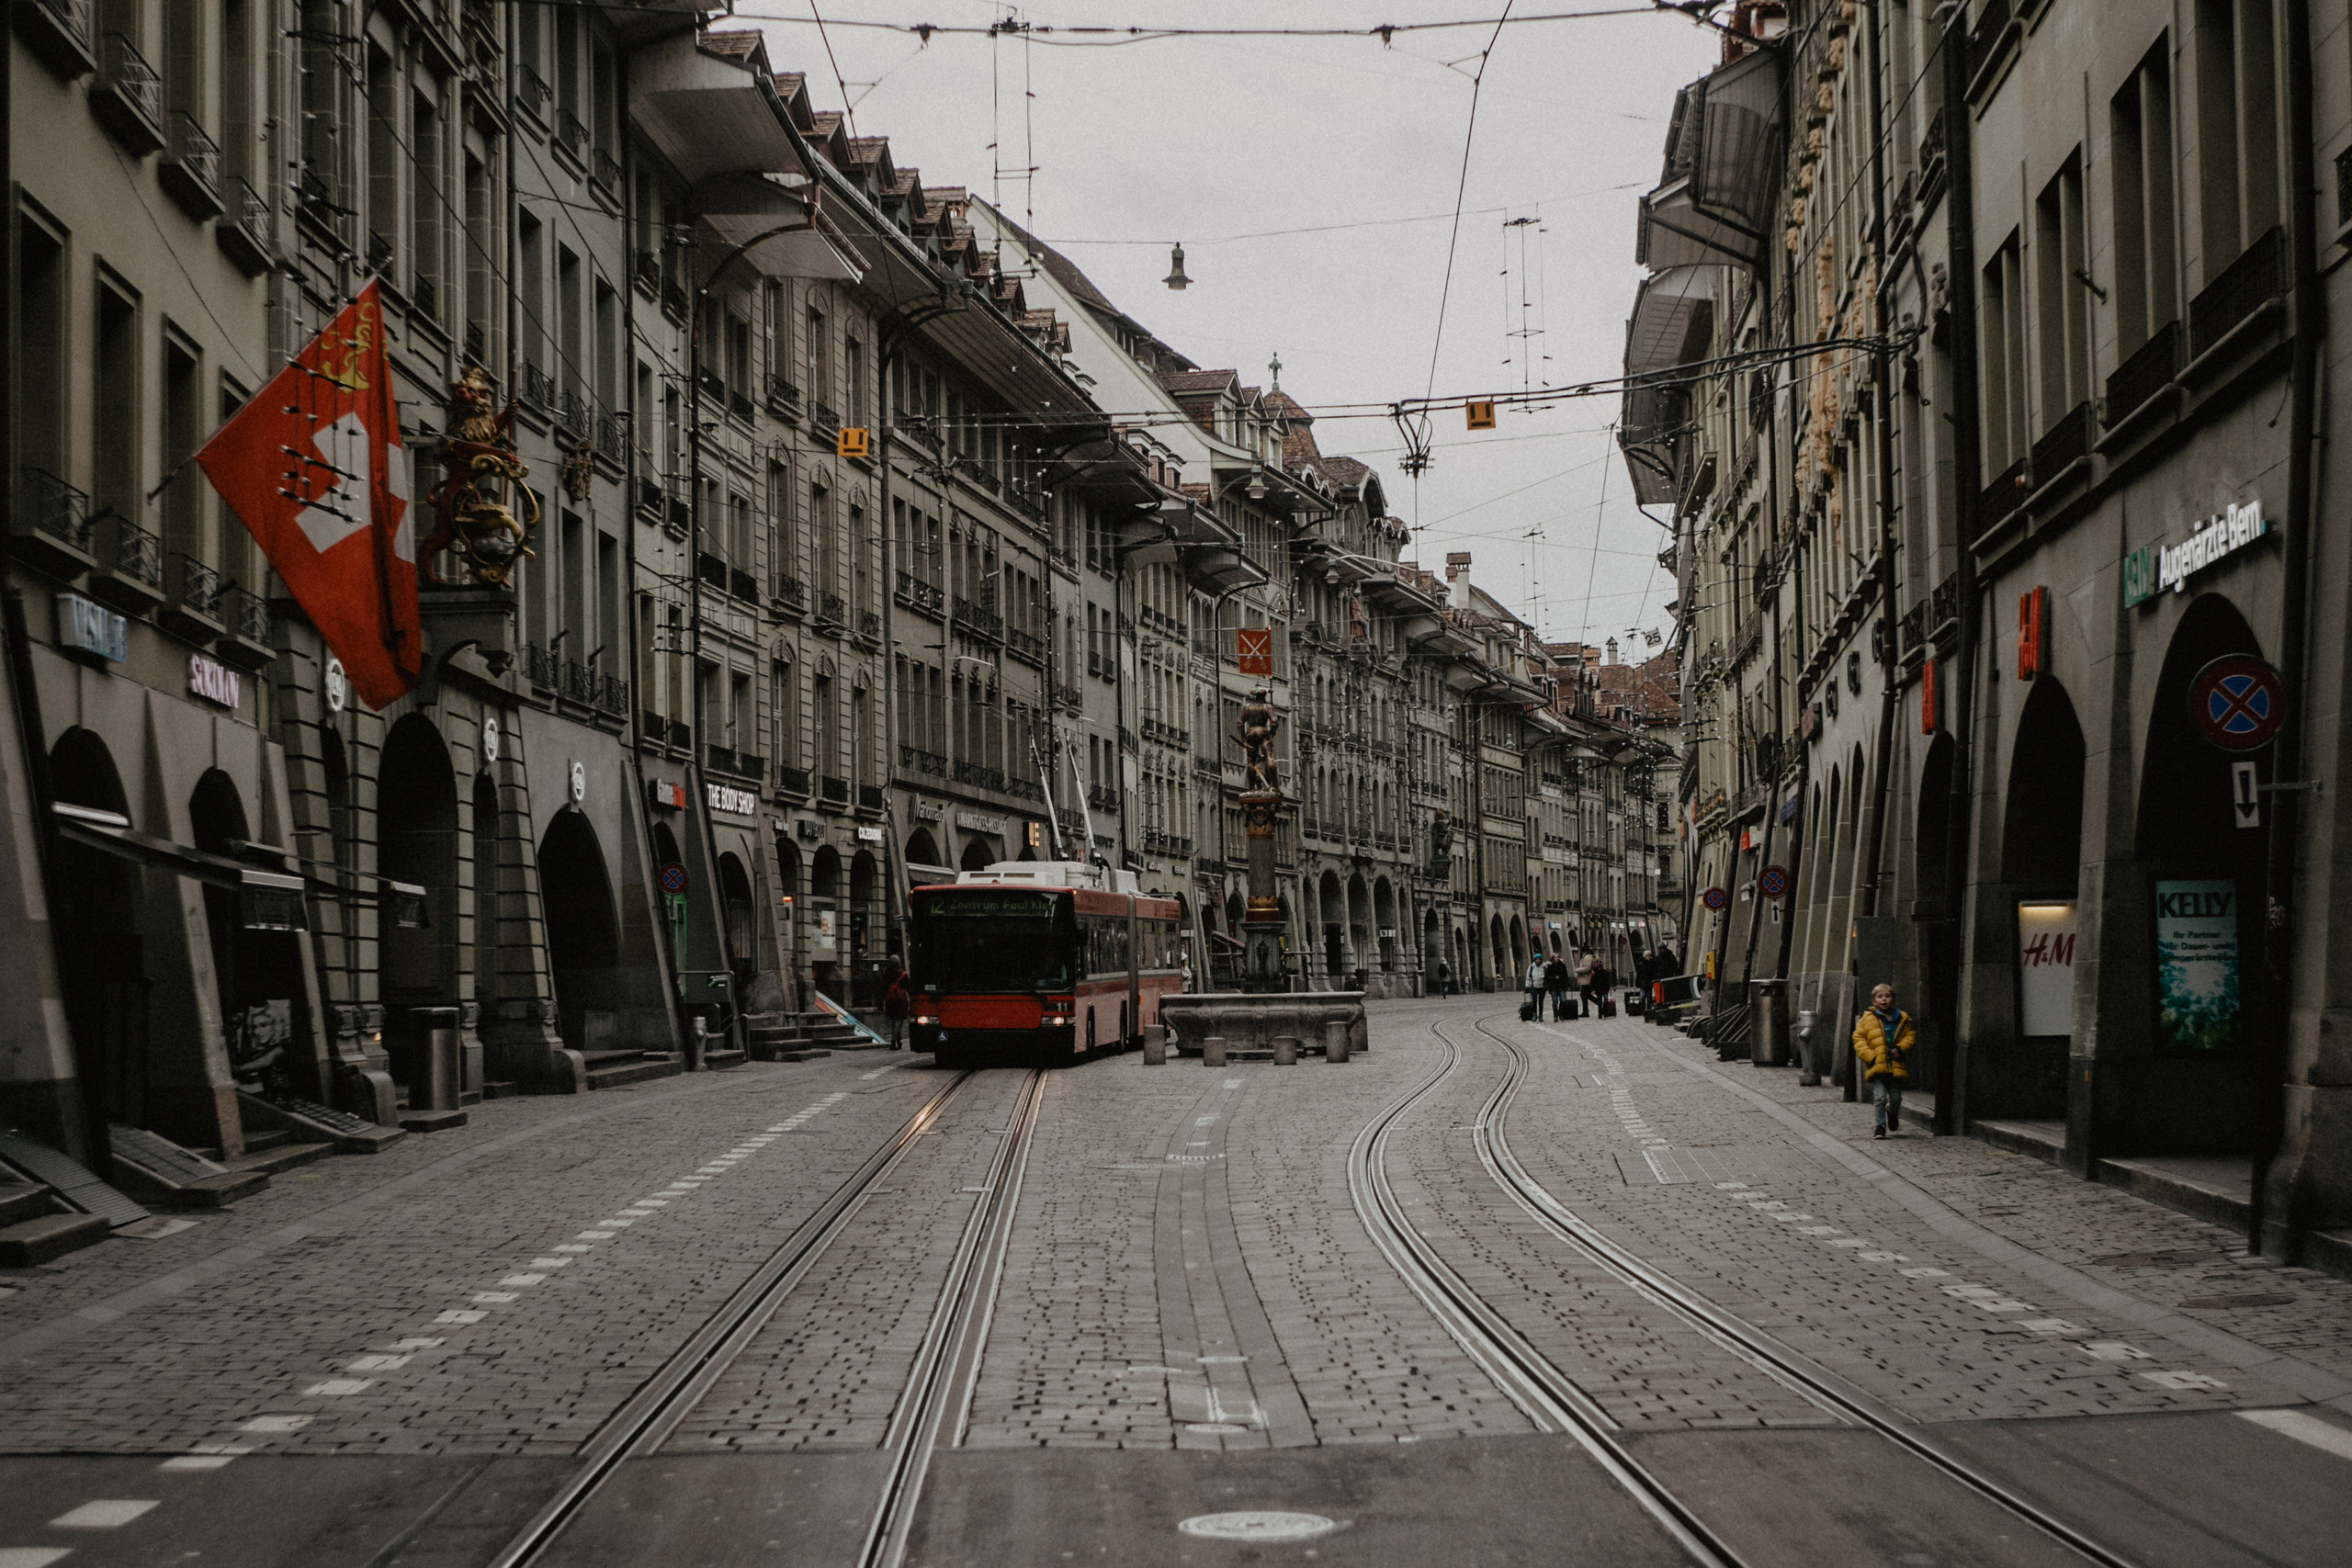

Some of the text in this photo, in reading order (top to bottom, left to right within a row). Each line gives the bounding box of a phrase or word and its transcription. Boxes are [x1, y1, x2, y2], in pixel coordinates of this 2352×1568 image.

[2159, 514, 2228, 593] Augenärzte
[1645, 632, 1661, 646] 25
[190, 653, 240, 709] SOKOLOV
[707, 784, 754, 816] THE BODY SHOP
[931, 897, 944, 914] 12
[950, 899, 1000, 910] Zentrum
[1003, 899, 1028, 910] Paul
[2159, 892, 2233, 918] KELLY
[2188, 931, 2222, 939] Partner
[2023, 932, 2075, 967] H&M
[1057, 1002, 1069, 1012] 11
